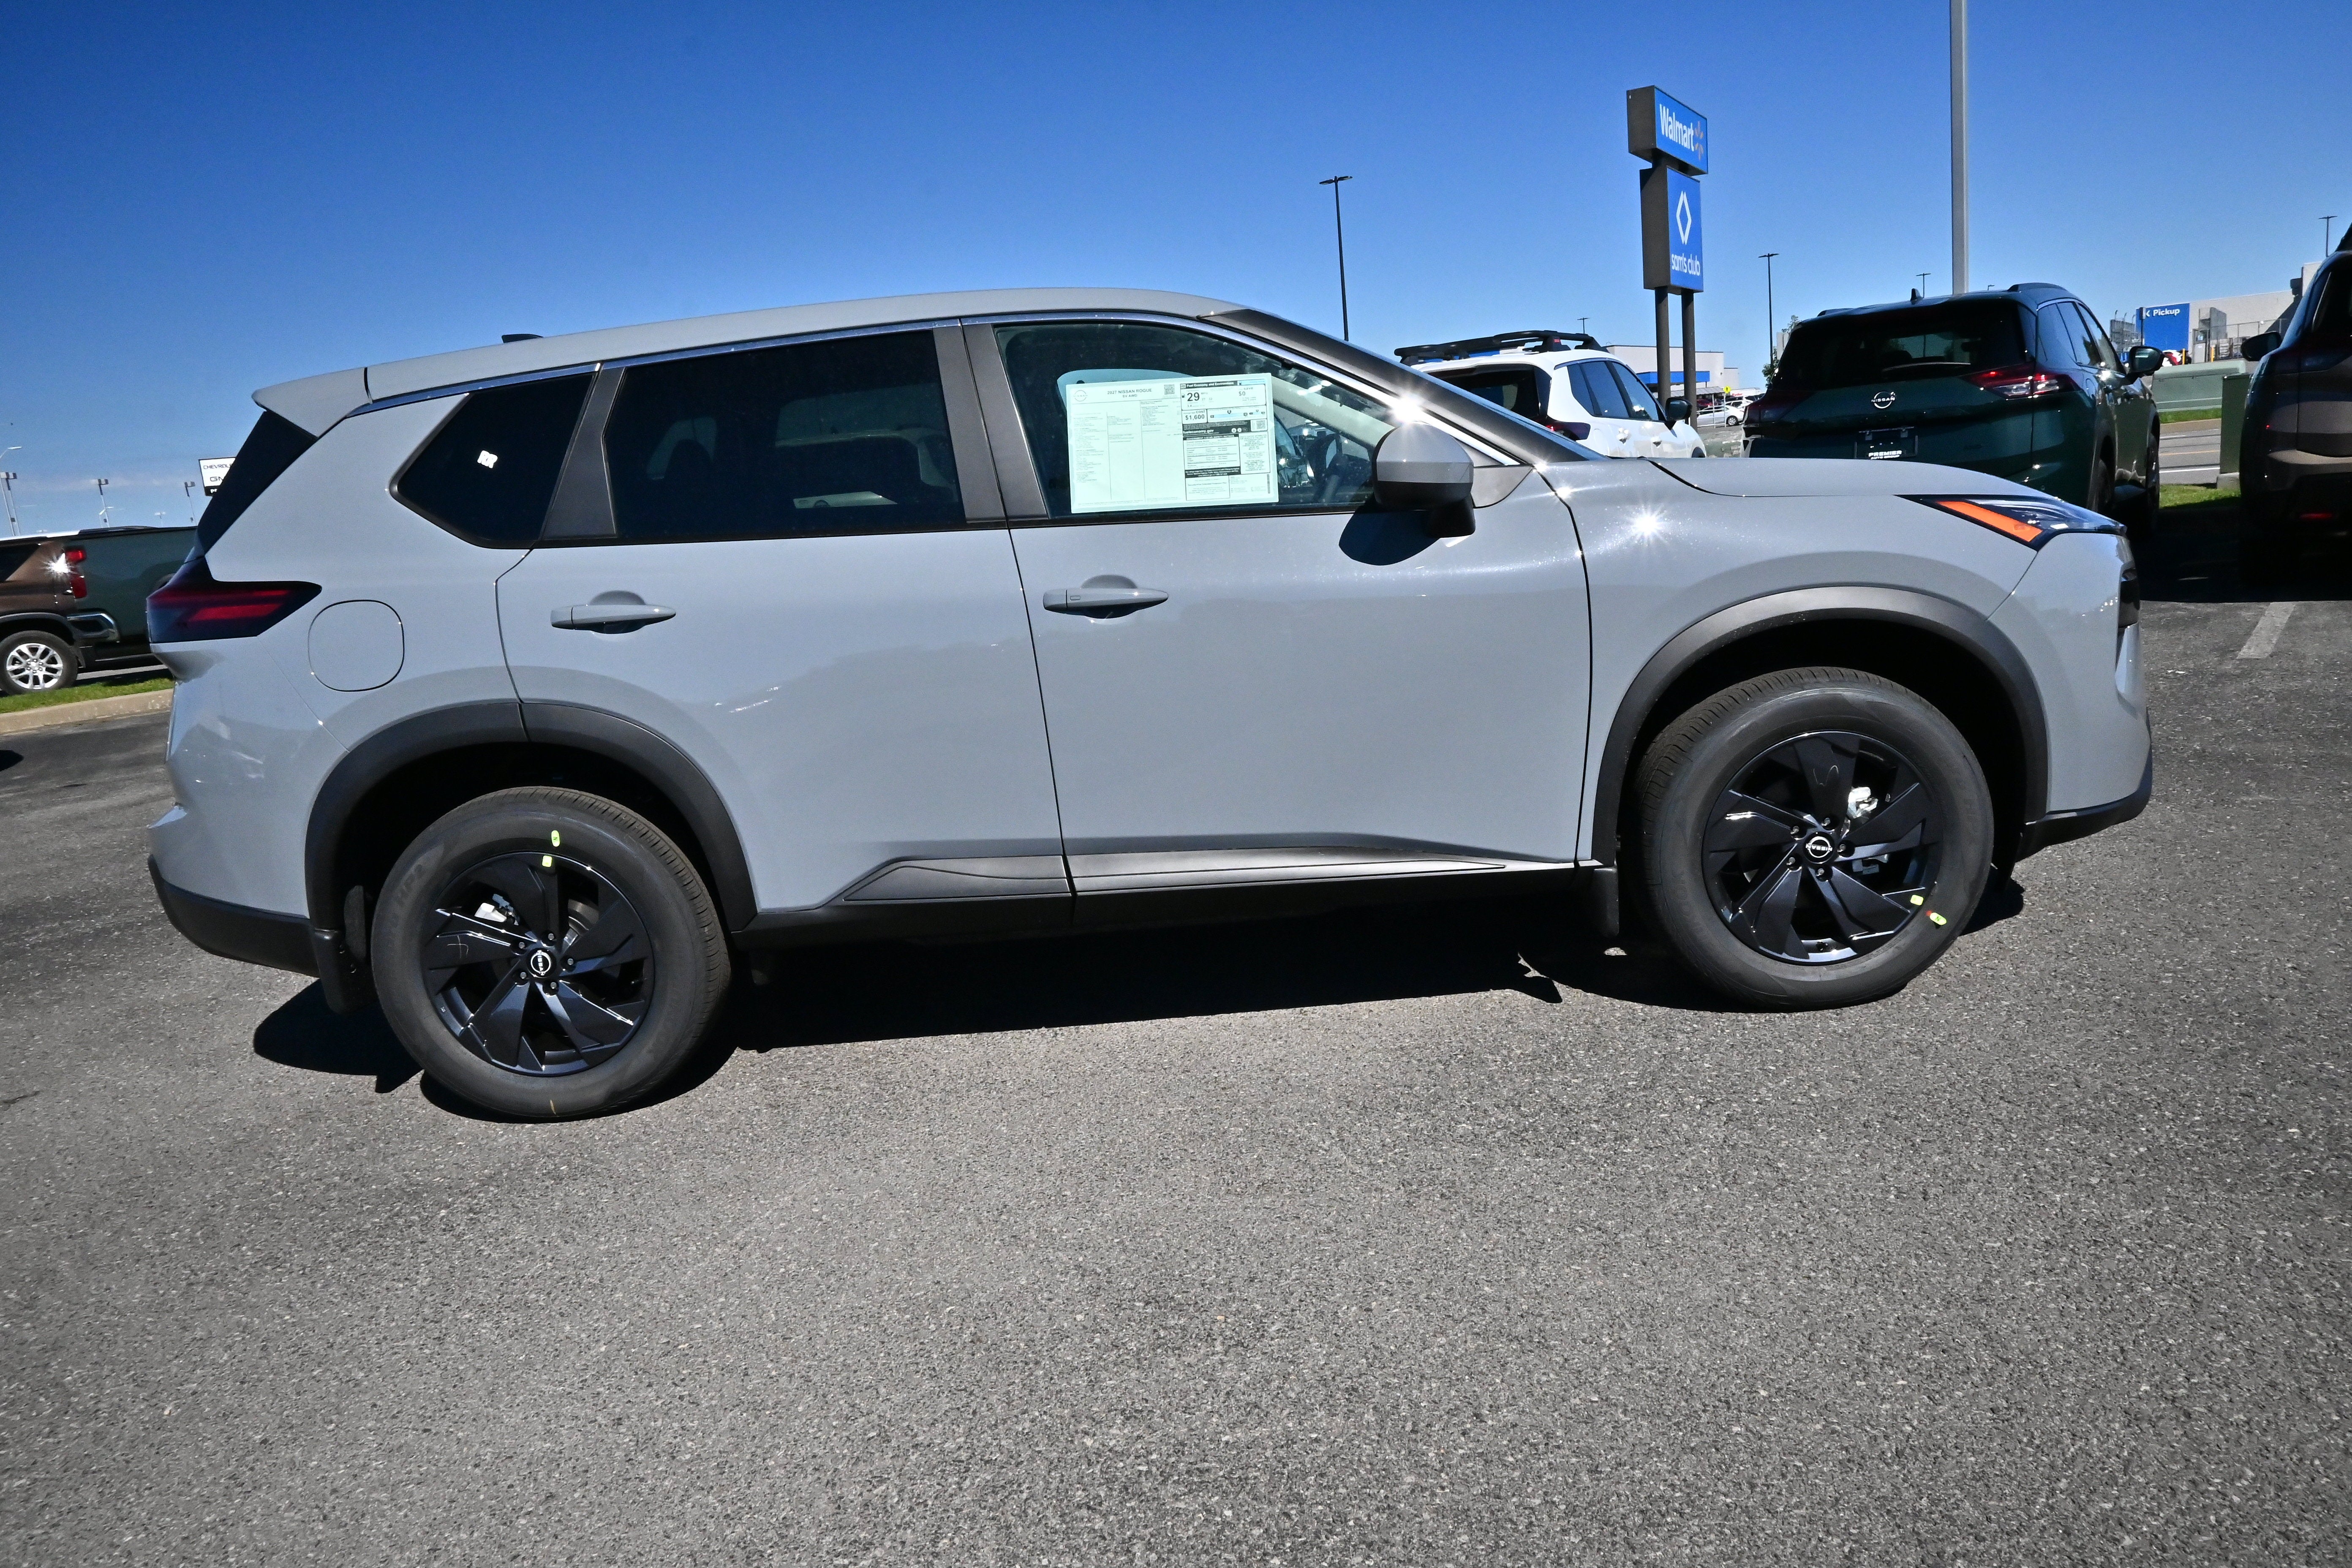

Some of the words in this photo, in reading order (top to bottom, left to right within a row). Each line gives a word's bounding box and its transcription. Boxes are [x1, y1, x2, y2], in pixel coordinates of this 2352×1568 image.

[1659, 103, 1694, 152] Walmart
[1671, 253, 1687, 273] sam's
[1688, 253, 1700, 276] club
[2153, 308, 2180, 316] Pickup
[1187, 392, 1200, 401] 29
[1805, 843, 1832, 852] NISSAN
[537, 950, 545, 976] NISSAN
